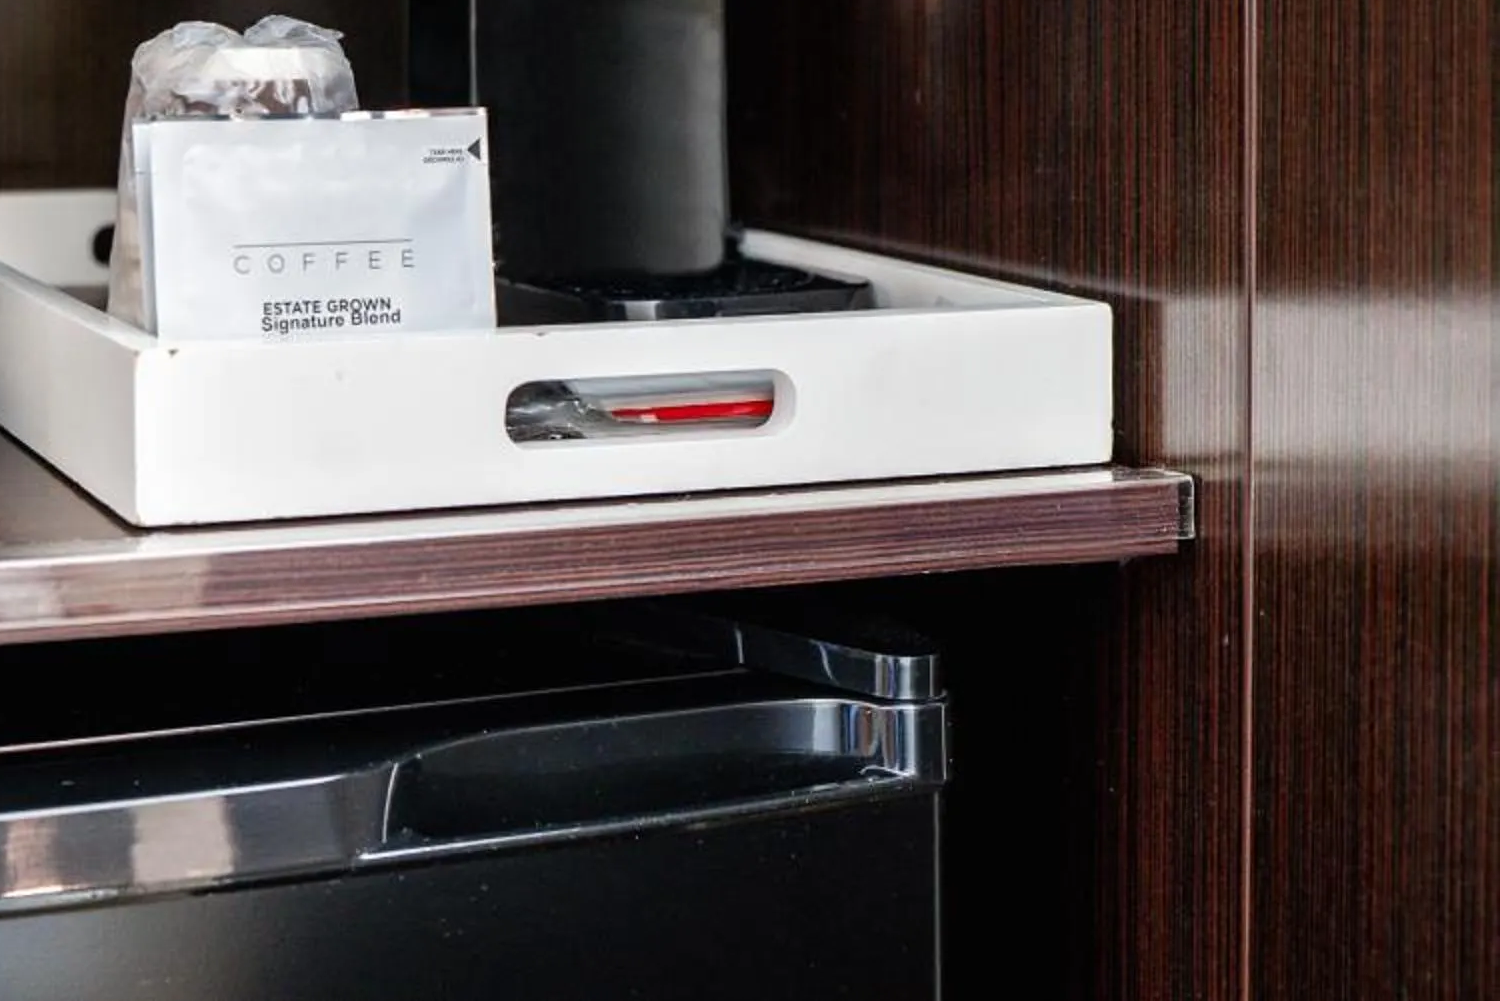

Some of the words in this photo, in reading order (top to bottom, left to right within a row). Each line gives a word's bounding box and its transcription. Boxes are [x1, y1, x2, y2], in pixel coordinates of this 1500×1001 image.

[235, 249, 415, 274] COFFEE
[263, 300, 321, 316] ESTATE
[327, 297, 391, 313] GROWN
[261, 316, 344, 334] Signature
[351, 309, 401, 326] Blend
